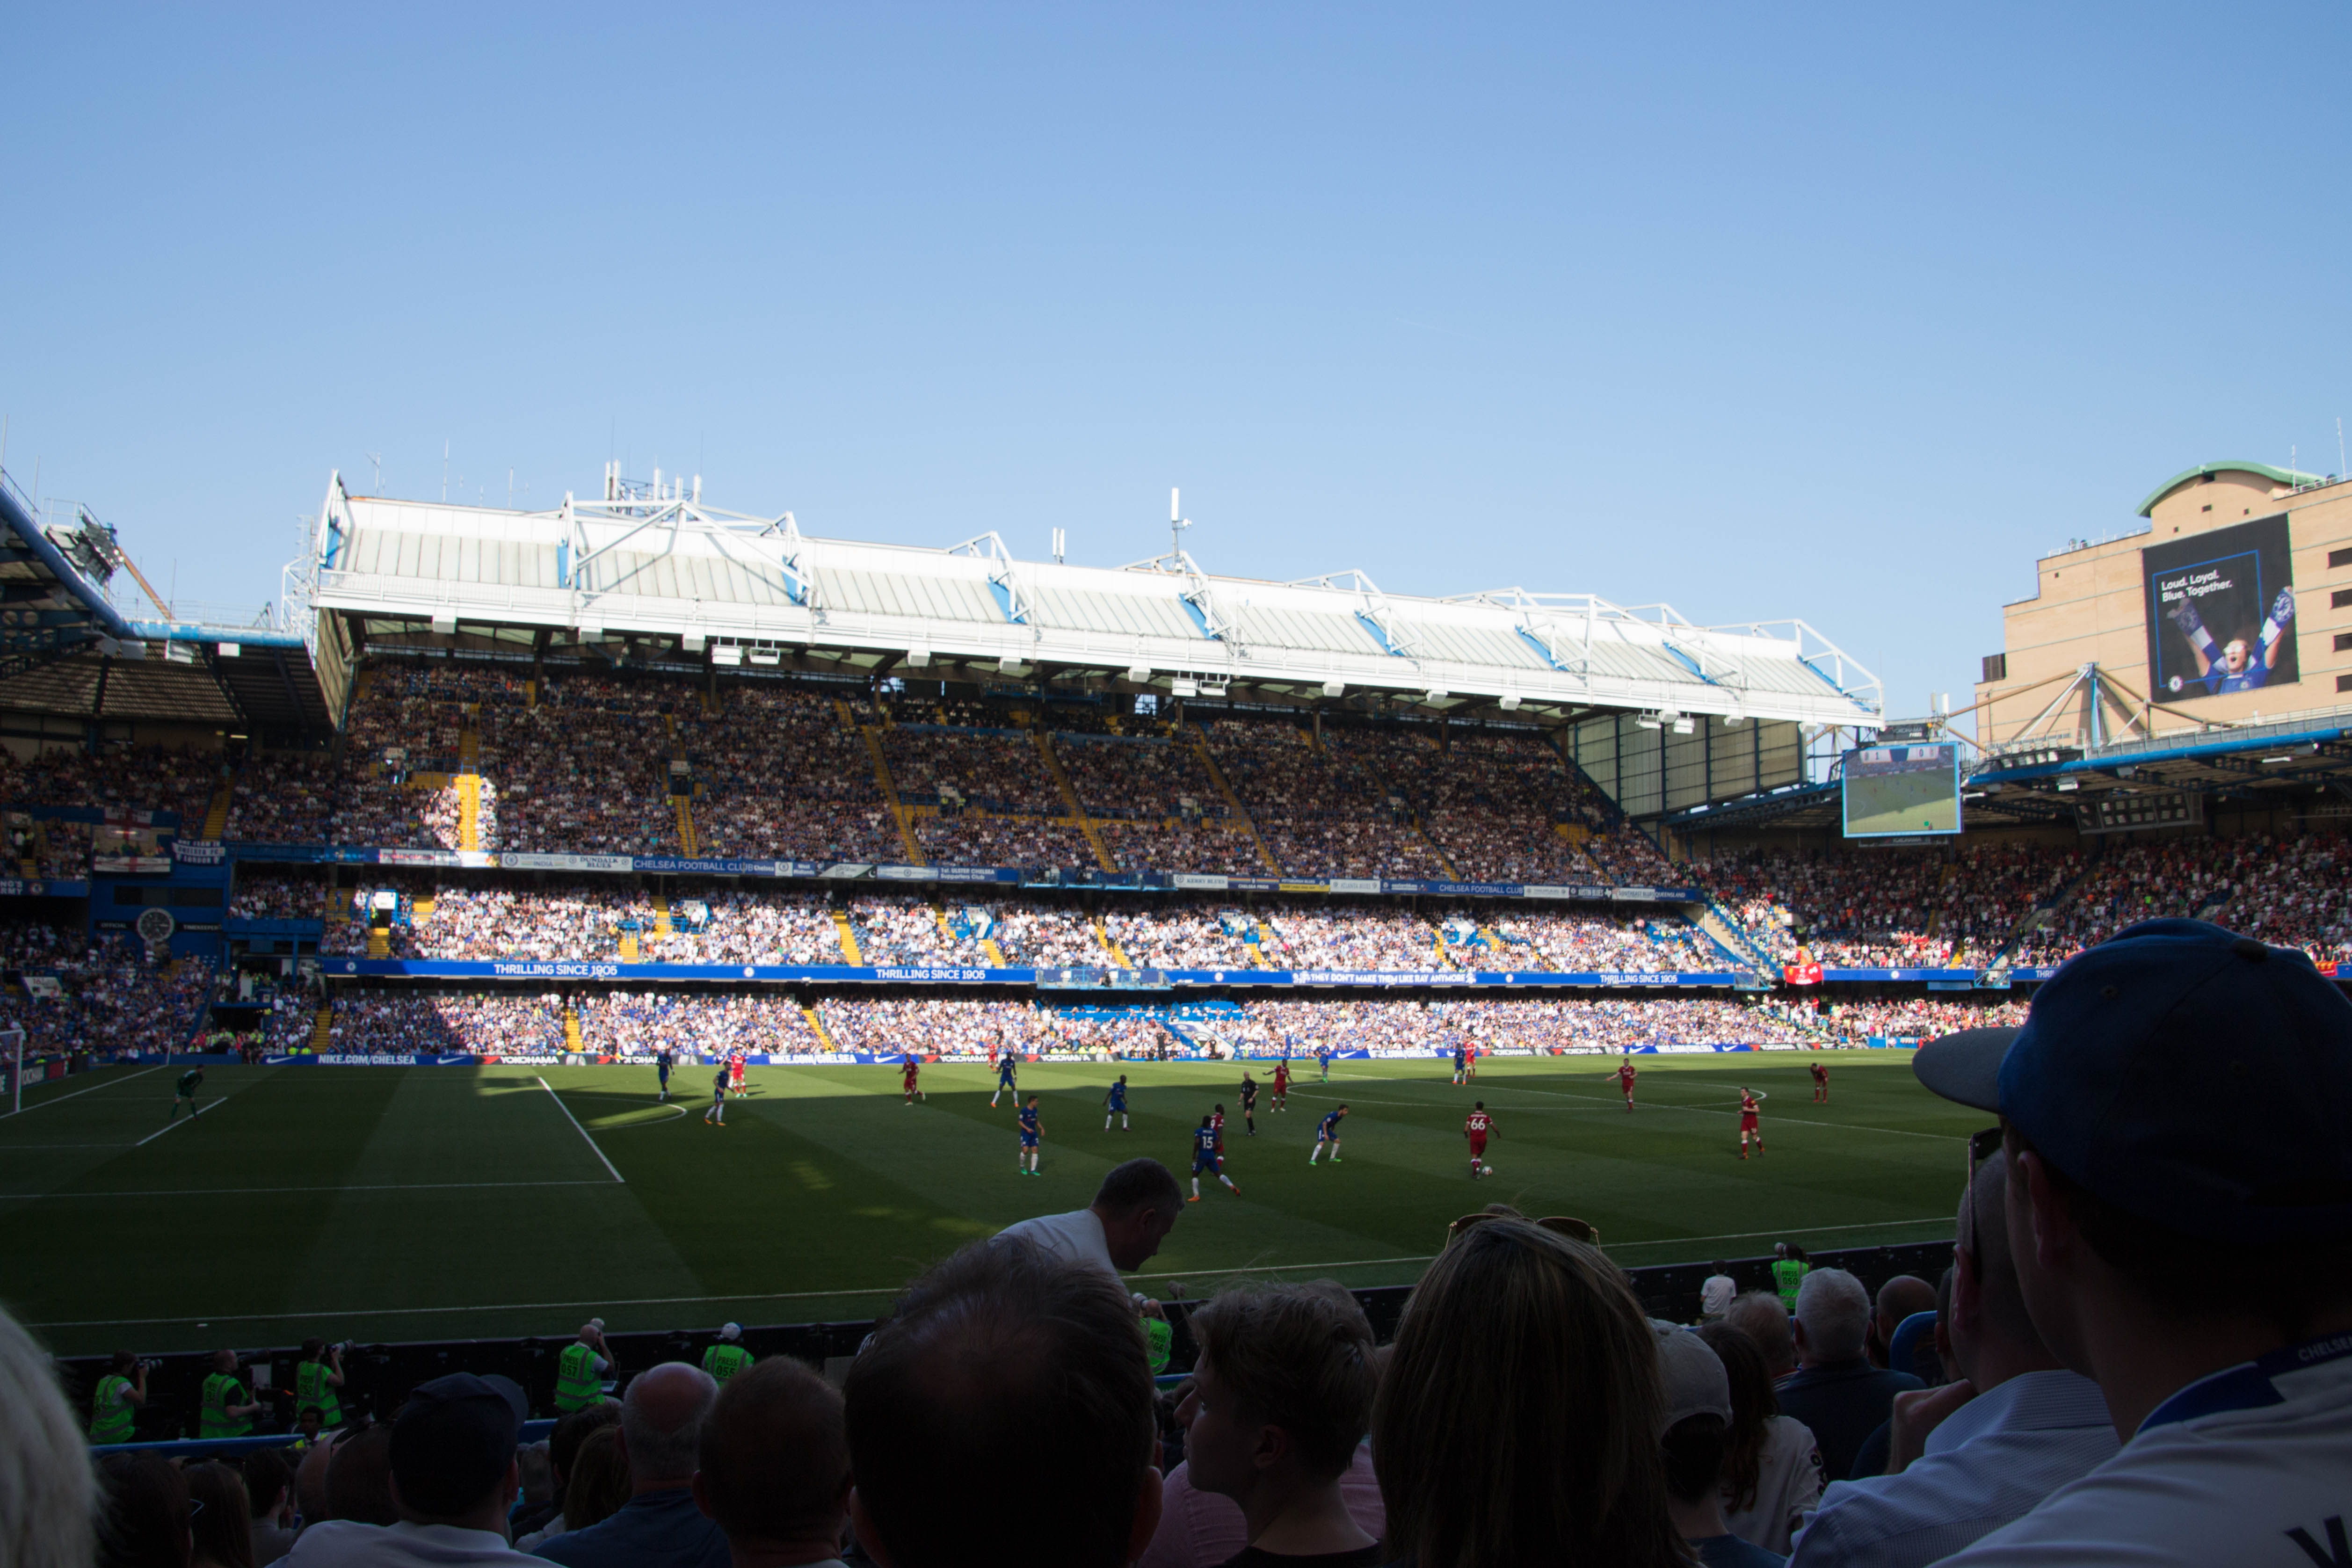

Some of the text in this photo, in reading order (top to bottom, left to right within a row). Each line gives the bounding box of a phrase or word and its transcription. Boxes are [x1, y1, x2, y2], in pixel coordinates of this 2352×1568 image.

[2161, 569, 2220, 591] Loud. Loyal.
[2162, 580, 2233, 602] Blue. Together.
[634, 860, 754, 872] CHELSEA FOOTBALL CLUB
[494, 964, 617, 975] THRILLING SINCE 1905
[876, 969, 985, 980] THRILLING SINCE 1905
[1331, 973, 1355, 982] DON'T
[1356, 974, 1377, 982] MAKE
[1378, 974, 1398, 983] THEM
[1399, 974, 1414, 983] LIKE
[1415, 974, 1429, 982] RAY
[1431, 974, 1465, 982] ANYMORE
[1600, 974, 1637, 983] THRILLING
[1639, 975, 1659, 983] SINCE
[318, 1054, 416, 1066] NIKE.COM/CHELSEA
[501, 1056, 559, 1064] YOKOHAMA
[769, 1054, 857, 1064] NIKE.COM/CHELSEA
[1471, 1118, 1486, 1130] 66
[1202, 1136, 1213, 1149] 15
[718, 1356, 738, 1366] PRESS
[562, 1365, 577, 1377] 057
